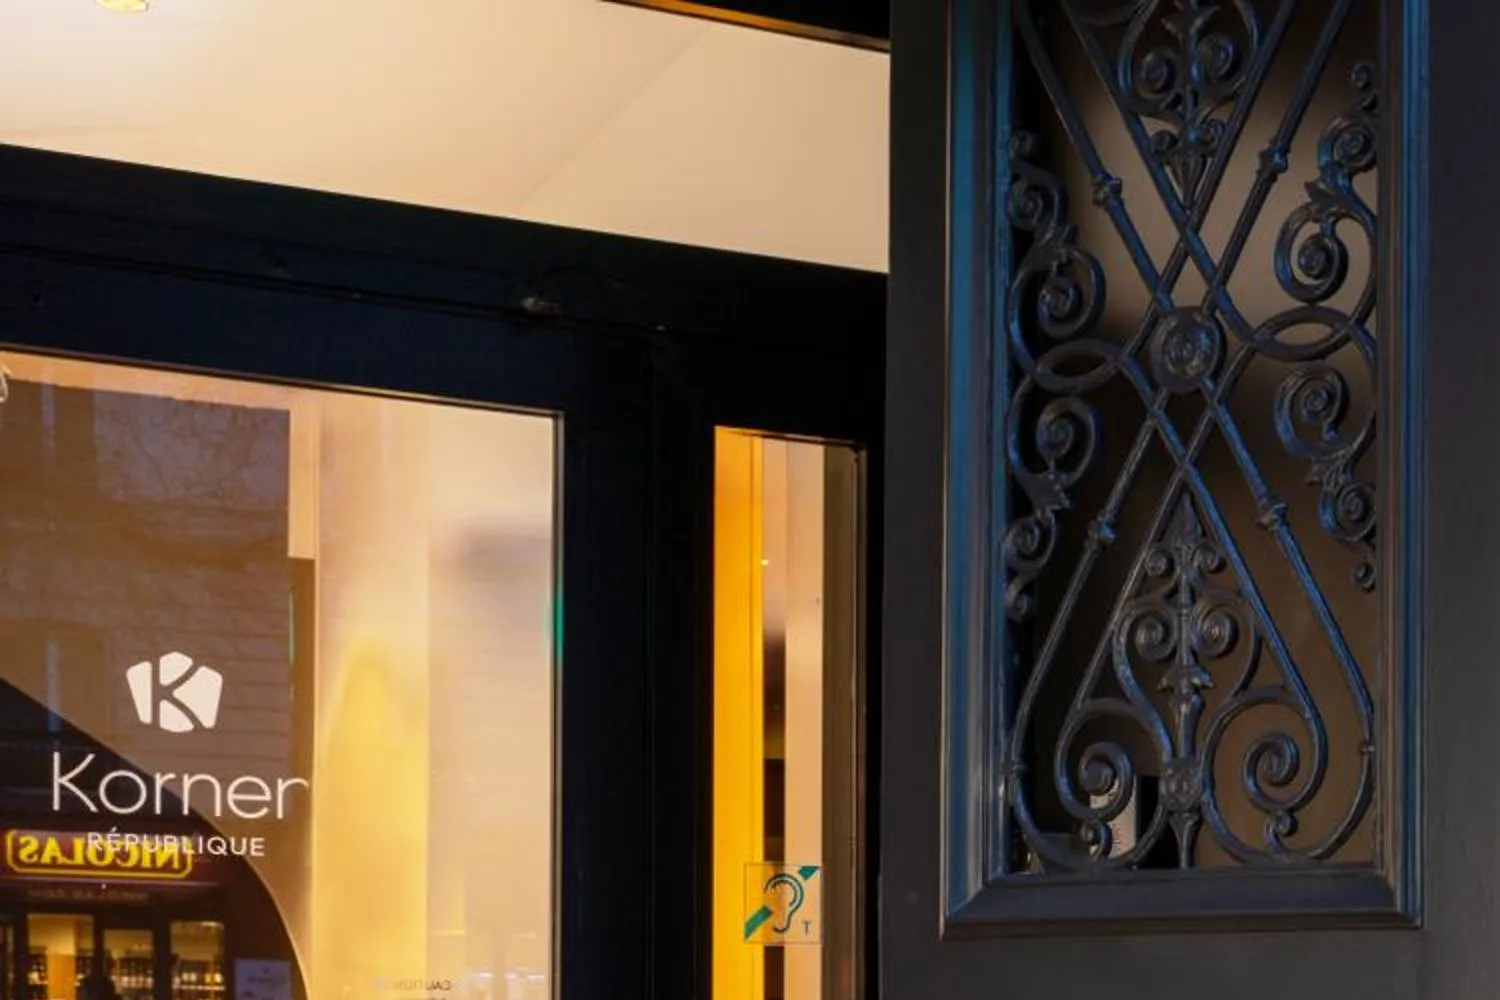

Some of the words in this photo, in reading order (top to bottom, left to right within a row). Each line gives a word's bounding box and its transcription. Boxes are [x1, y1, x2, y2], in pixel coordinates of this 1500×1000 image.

[51, 751, 311, 820] Korner
[86, 825, 266, 858] RÉPUBLIQUE
[801, 920, 812, 935] T
